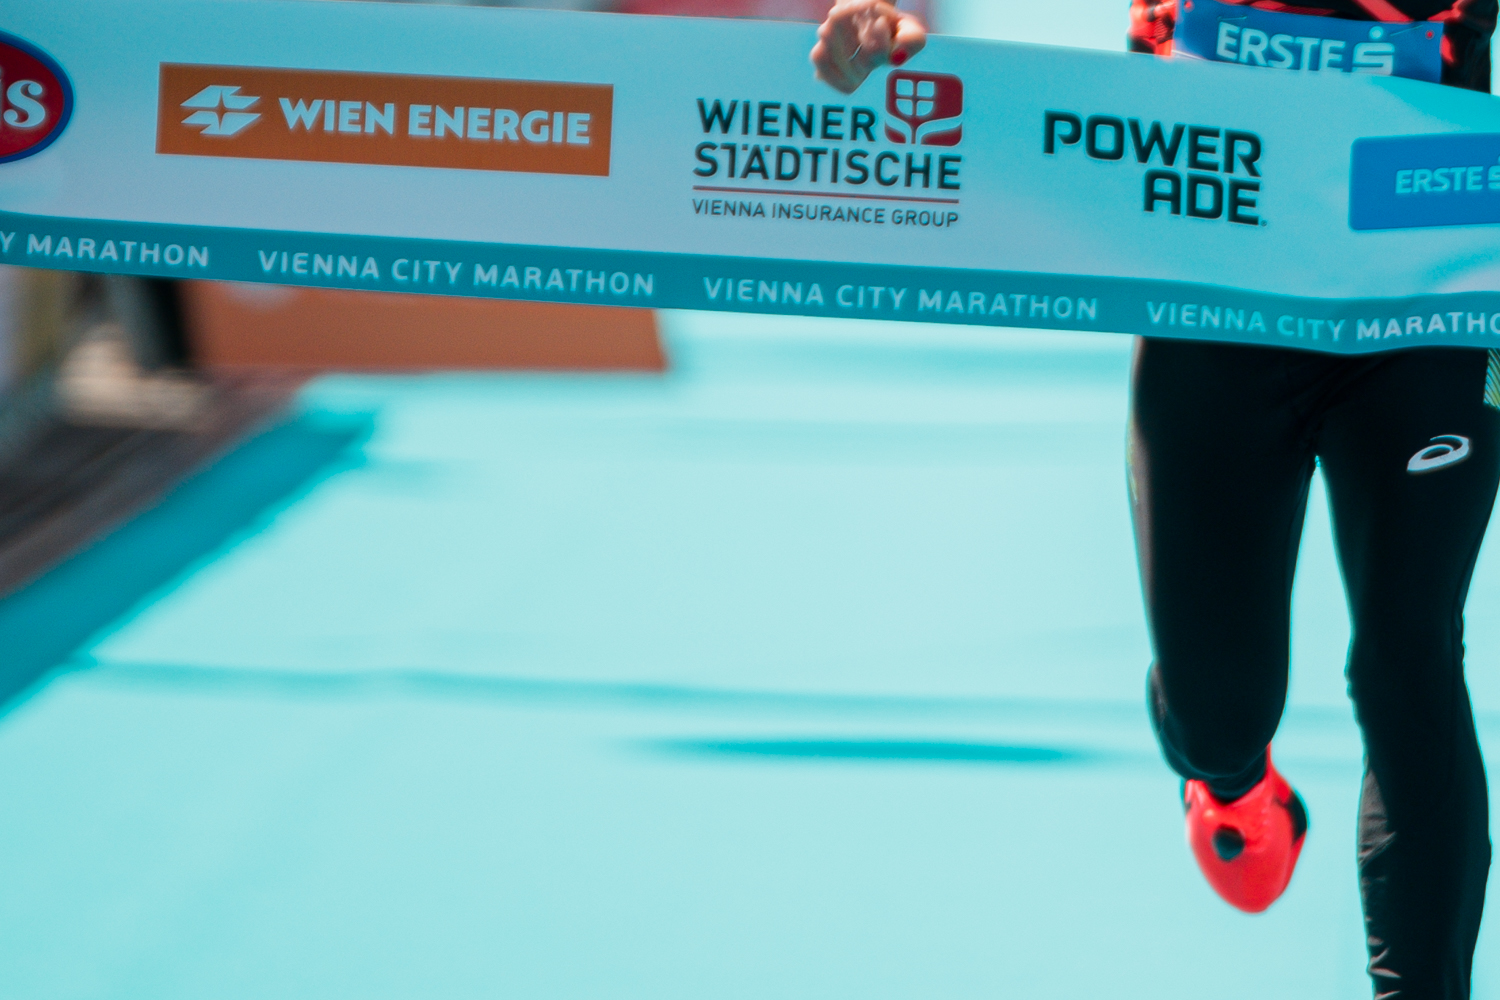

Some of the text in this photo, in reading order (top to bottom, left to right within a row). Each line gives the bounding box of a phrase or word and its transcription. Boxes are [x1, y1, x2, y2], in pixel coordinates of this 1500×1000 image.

[1216, 21, 1346, 72] ERSTE
[278, 97, 591, 145] WIEN ENERGIE
[696, 98, 876, 142] WIENER
[692, 141, 962, 190] STÄDTISCHE
[1043, 109, 1262, 178] POWER
[1143, 169, 1261, 227] ADE
[1395, 166, 1484, 194] ERSTE
[692, 199, 959, 228] VIENNA INSURANCE GROUP
[26, 233, 209, 268] MARATHON
[257, 250, 654, 295] VIENNA CITY MARATHON
[703, 276, 1098, 322] VIENNA CITY MARATHON
[1146, 301, 1267, 333] VIENNA
[1276, 314, 1347, 342] CITY
